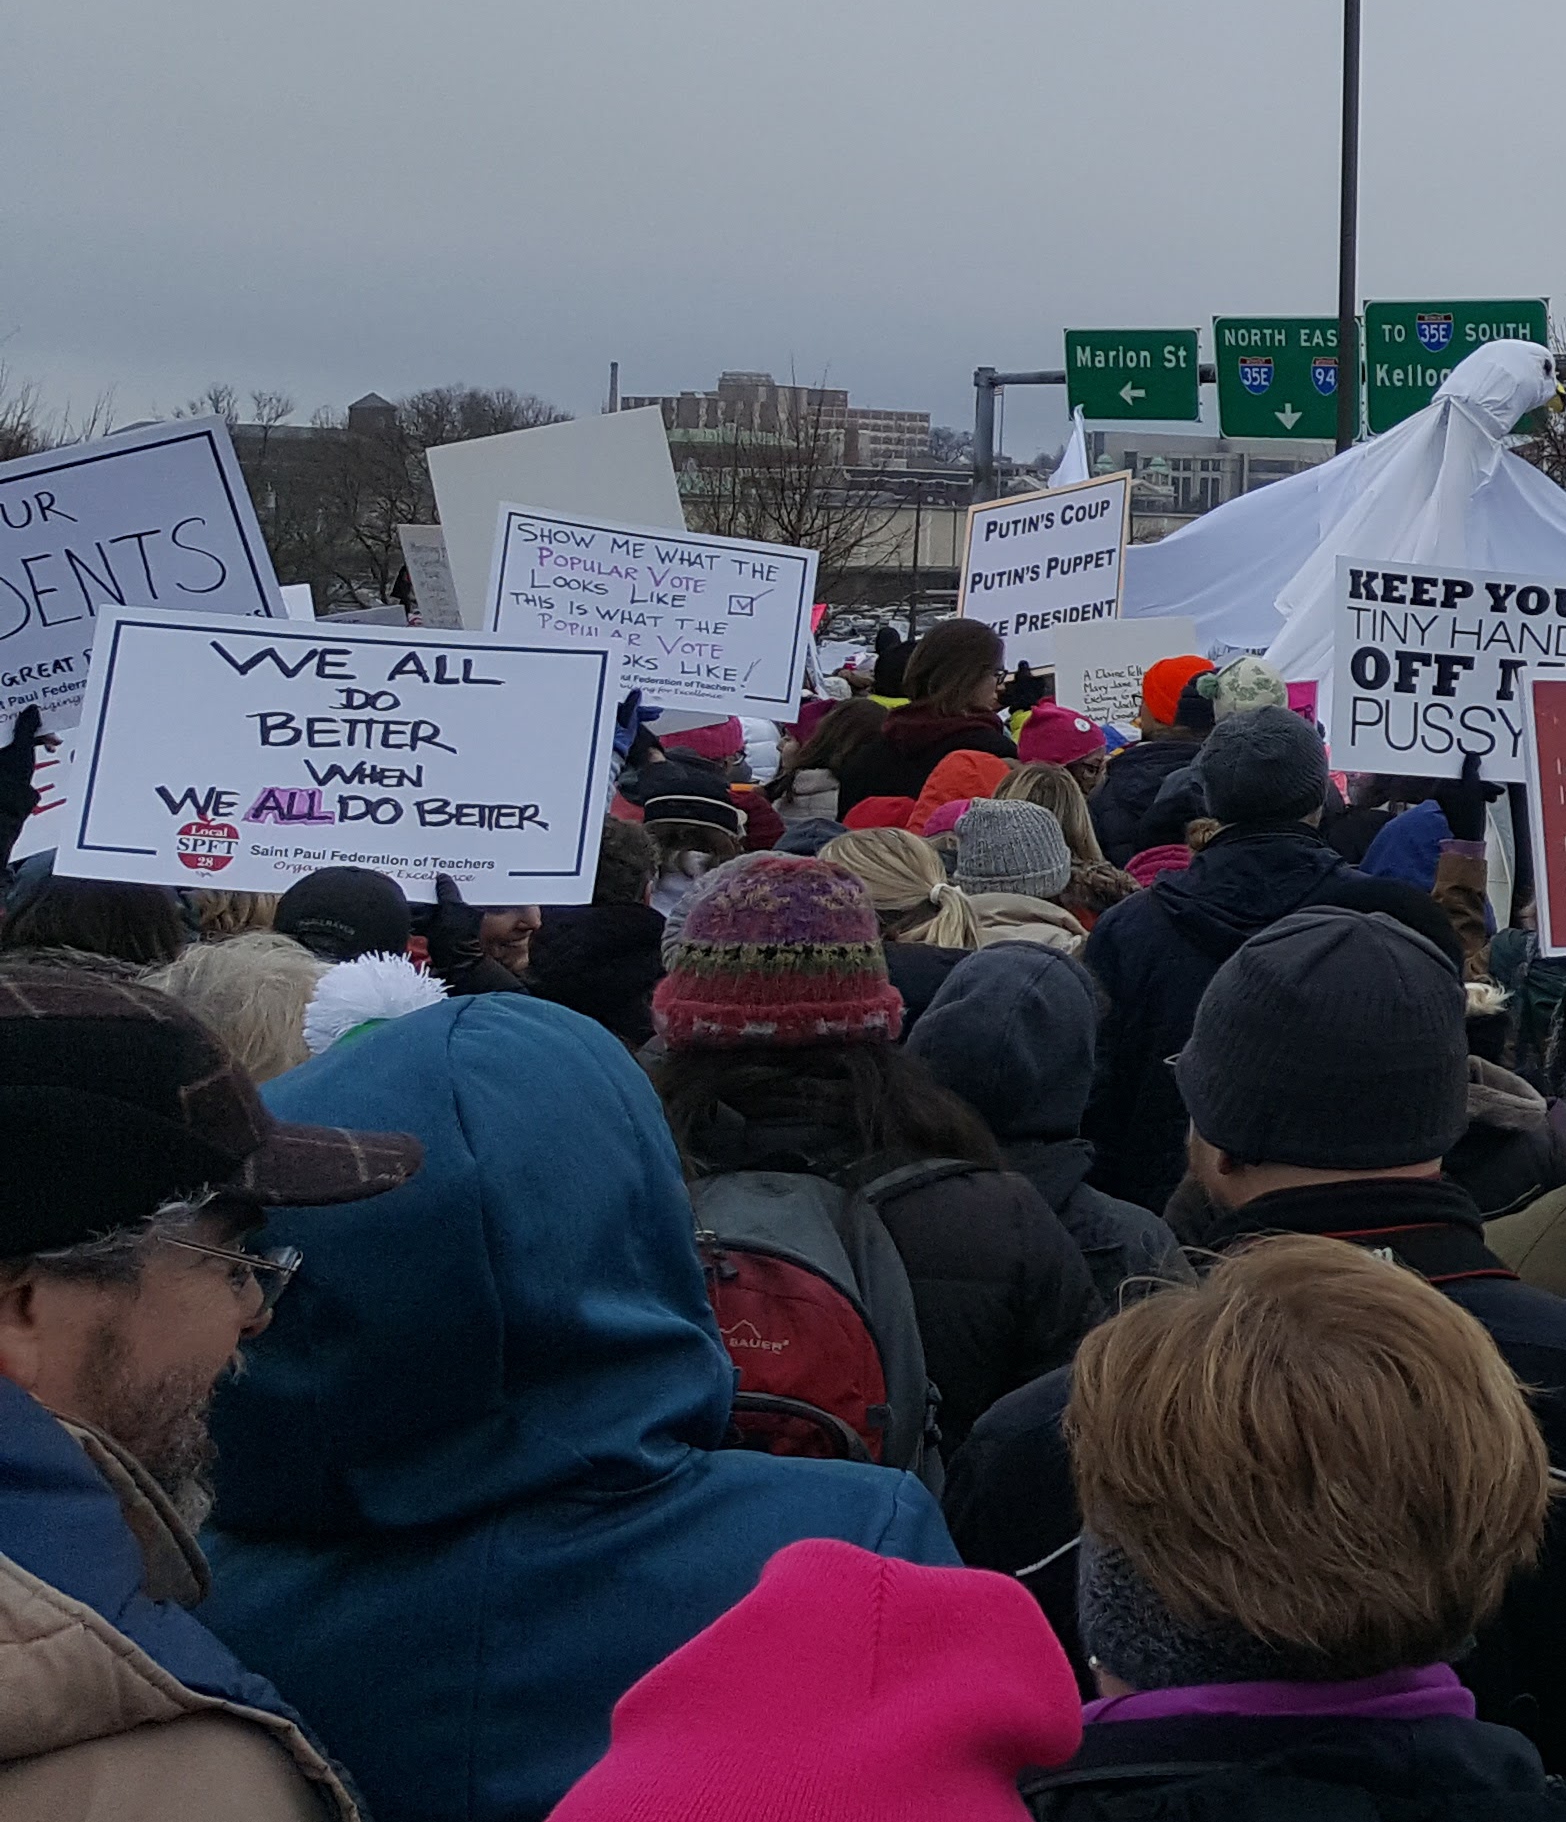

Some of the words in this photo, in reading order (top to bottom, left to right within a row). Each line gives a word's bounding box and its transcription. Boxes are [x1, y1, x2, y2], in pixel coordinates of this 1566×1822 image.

[1224, 328, 1286, 347] NORTH
[1300, 328, 1338, 347] EAS
[1382, 324, 1406, 342] TO
[1420, 323, 1448, 343] 35E
[1465, 323, 1531, 342] SOUTH
[1076, 345, 1150, 368] Marion
[1163, 345, 1187, 368] St
[1243, 367, 1269, 386] 35E
[1315, 367, 1336, 386] 94
[985, 512, 1055, 542] PUTIN'S
[1061, 499, 1111, 525] COUP
[517, 523, 596, 549] SHOW
[610, 537, 647, 559] ME
[654, 545, 721, 571] WHAT
[731, 559, 780, 582] THE
[537, 547, 638, 581] POPULAR
[646, 566, 707, 594] VOTE
[970, 564, 1041, 593] PUTIN'S
[1046, 548, 1117, 579] PUPPET
[530, 569, 609, 595] LOOKS
[630, 584, 687, 608] LIKE
[1349, 568, 1474, 609] KEEP
[510, 592, 555, 610] THIS
[569, 601, 588, 615] IS
[596, 606, 664, 629] WHAT
[675, 618, 729, 635] THE
[1014, 599, 1117, 635] PRESIDENT
[1347, 606, 1439, 646] TINY
[657, 635, 724, 660] VOTE
[1, 656, 74, 687] GREAT
[209, 641, 357, 679] WE
[387, 651, 506, 686] ALL
[1350, 646, 1475, 698] OFF
[632, 675, 682, 687] Federation
[684, 680, 694, 688] of
[696, 682, 736, 693] Teachers
[8, 690, 39, 707] Paul
[329, 687, 401, 711] DO
[246, 711, 458, 755] BETTER
[1350, 696, 1524, 758] PUSSY
[303, 759, 422, 788] WHEN
[1557, 758, 1562, 775] I
[155, 785, 241, 818] WE
[251, 789, 334, 821] ALL
[338, 794, 404, 824] DO
[413, 799, 550, 831] BETTER
[1559, 785, 1565, 805] I
[191, 825, 228, 837] Local
[177, 837, 239, 855] SPFT
[250, 844, 289, 858] Saint
[293, 848, 326, 861] Paul
[330, 850, 408, 867] Federation
[413, 856, 428, 868] of
[431, 857, 496, 870] Teachers
[197, 857, 214, 867] 28
[397, 869, 476, 882] Excellnce
[729, 1337, 783, 1354] BAUER
